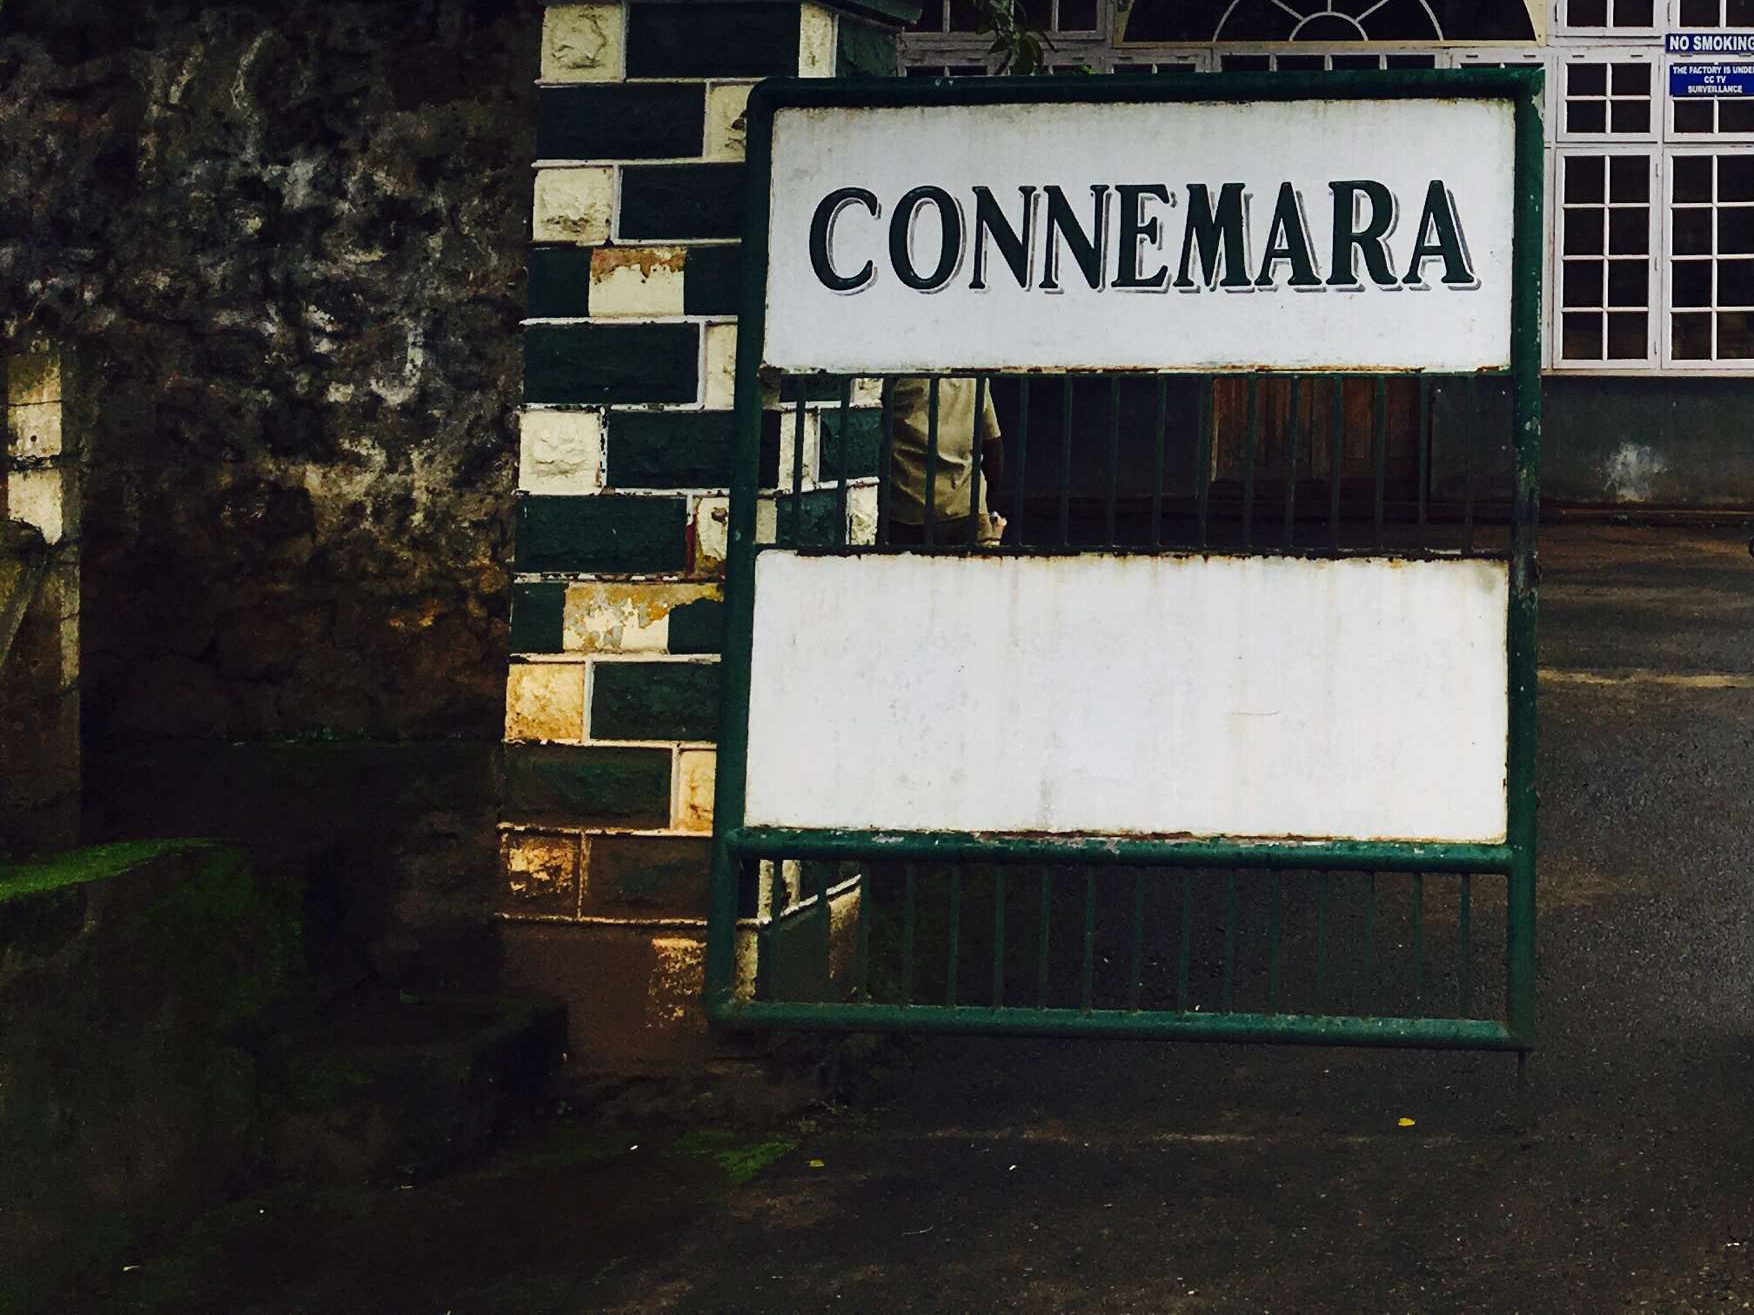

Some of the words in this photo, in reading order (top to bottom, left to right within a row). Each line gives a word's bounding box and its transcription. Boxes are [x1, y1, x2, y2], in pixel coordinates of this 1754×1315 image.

[1669, 35, 1689, 51] NO
[1672, 66, 1687, 74] THE
[1689, 66, 1721, 74] FACTORY
[1723, 66, 1731, 74] IS
[1704, 75, 1714, 83] CC
[1715, 75, 1727, 83] TV
[1687, 85, 1743, 94] SURVEILLANCE
[808, 179, 1482, 297] CONNEMARA
